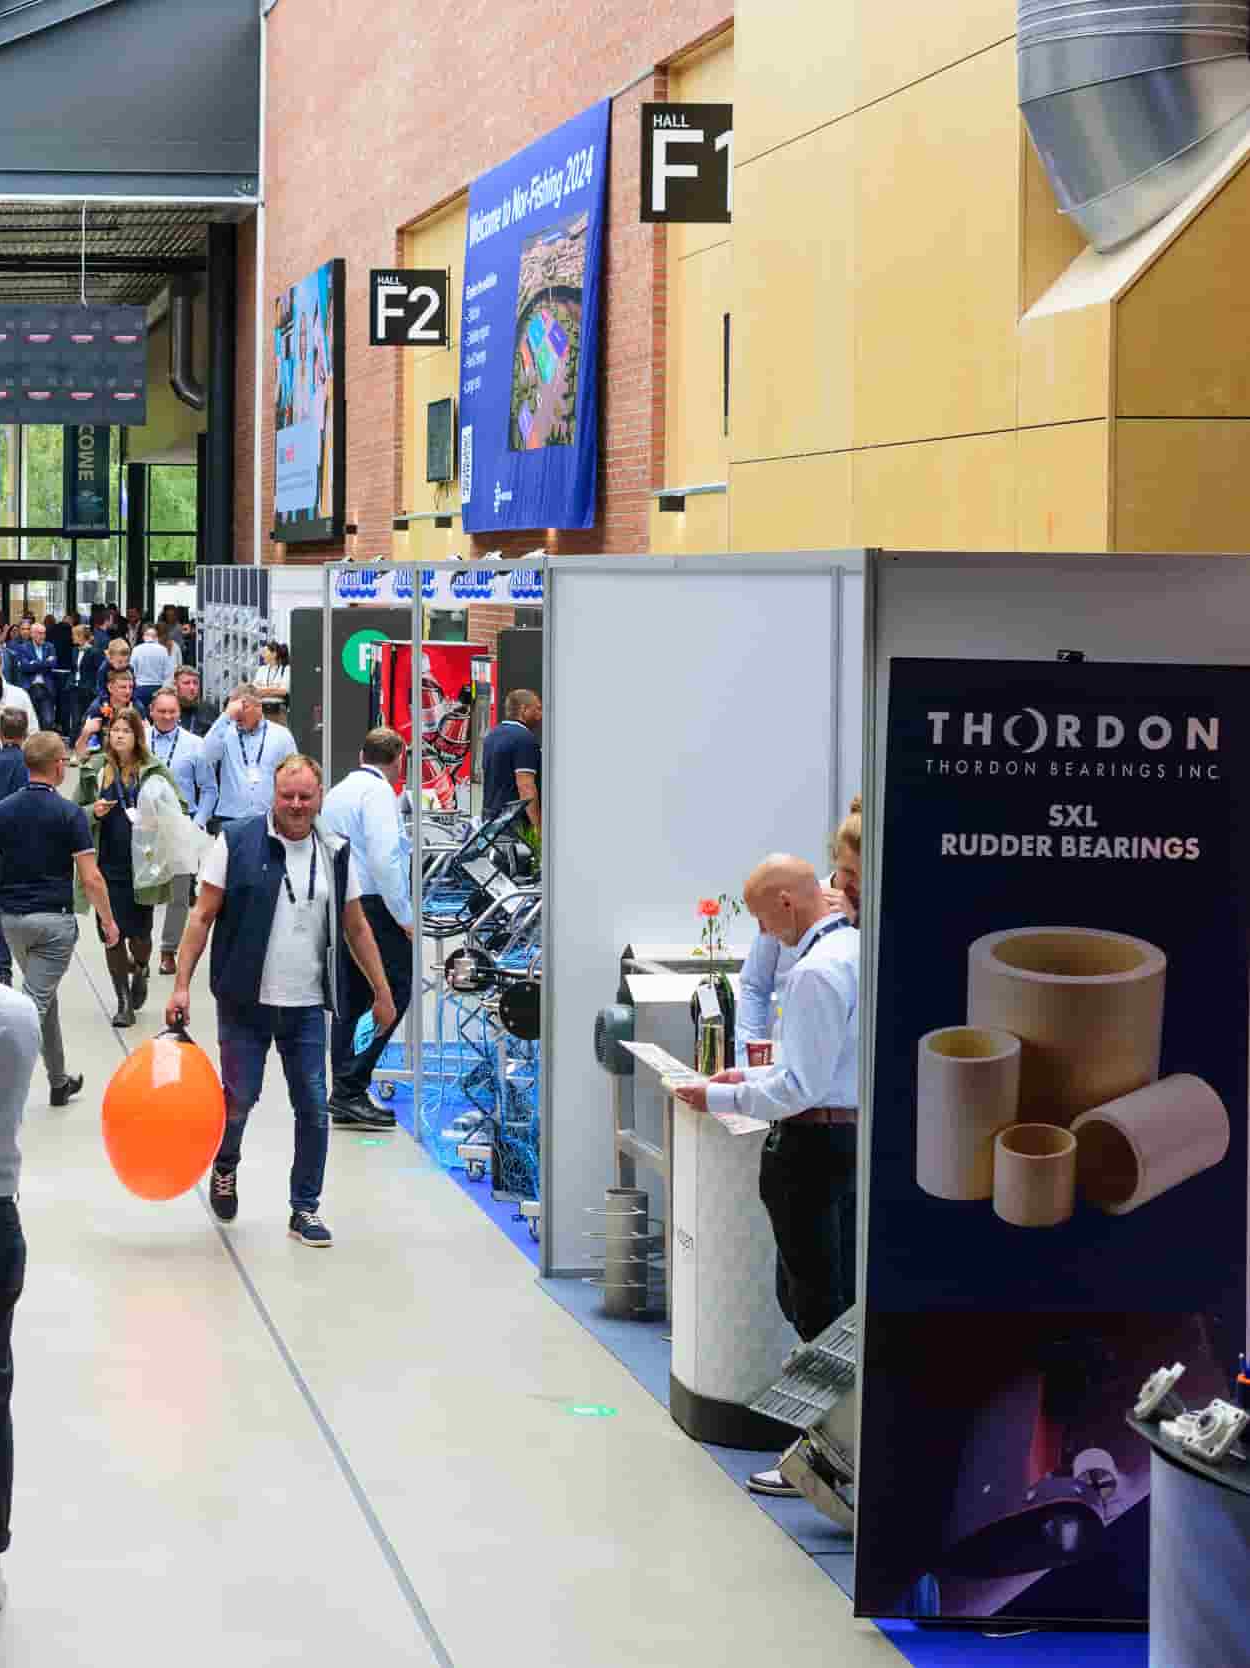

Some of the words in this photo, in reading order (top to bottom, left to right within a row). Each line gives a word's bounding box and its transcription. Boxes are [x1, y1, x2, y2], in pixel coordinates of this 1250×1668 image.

[653, 113, 691, 128] HALL
[511, 165, 564, 225] Nor-Fishing
[563, 144, 594, 196] 2024
[377, 275, 403, 286] HALL
[377, 286, 440, 339] F2
[77, 423, 95, 481] COME
[926, 707, 1220, 754] THORDON
[925, 758, 1037, 776] THORDON
[1050, 761, 1166, 778] BEARINGS
[1178, 764, 1221, 779] INC
[1048, 803, 1099, 828] SXL
[940, 833, 1053, 858] RUDDER
[1061, 836, 1201, 860] BEARINGS
